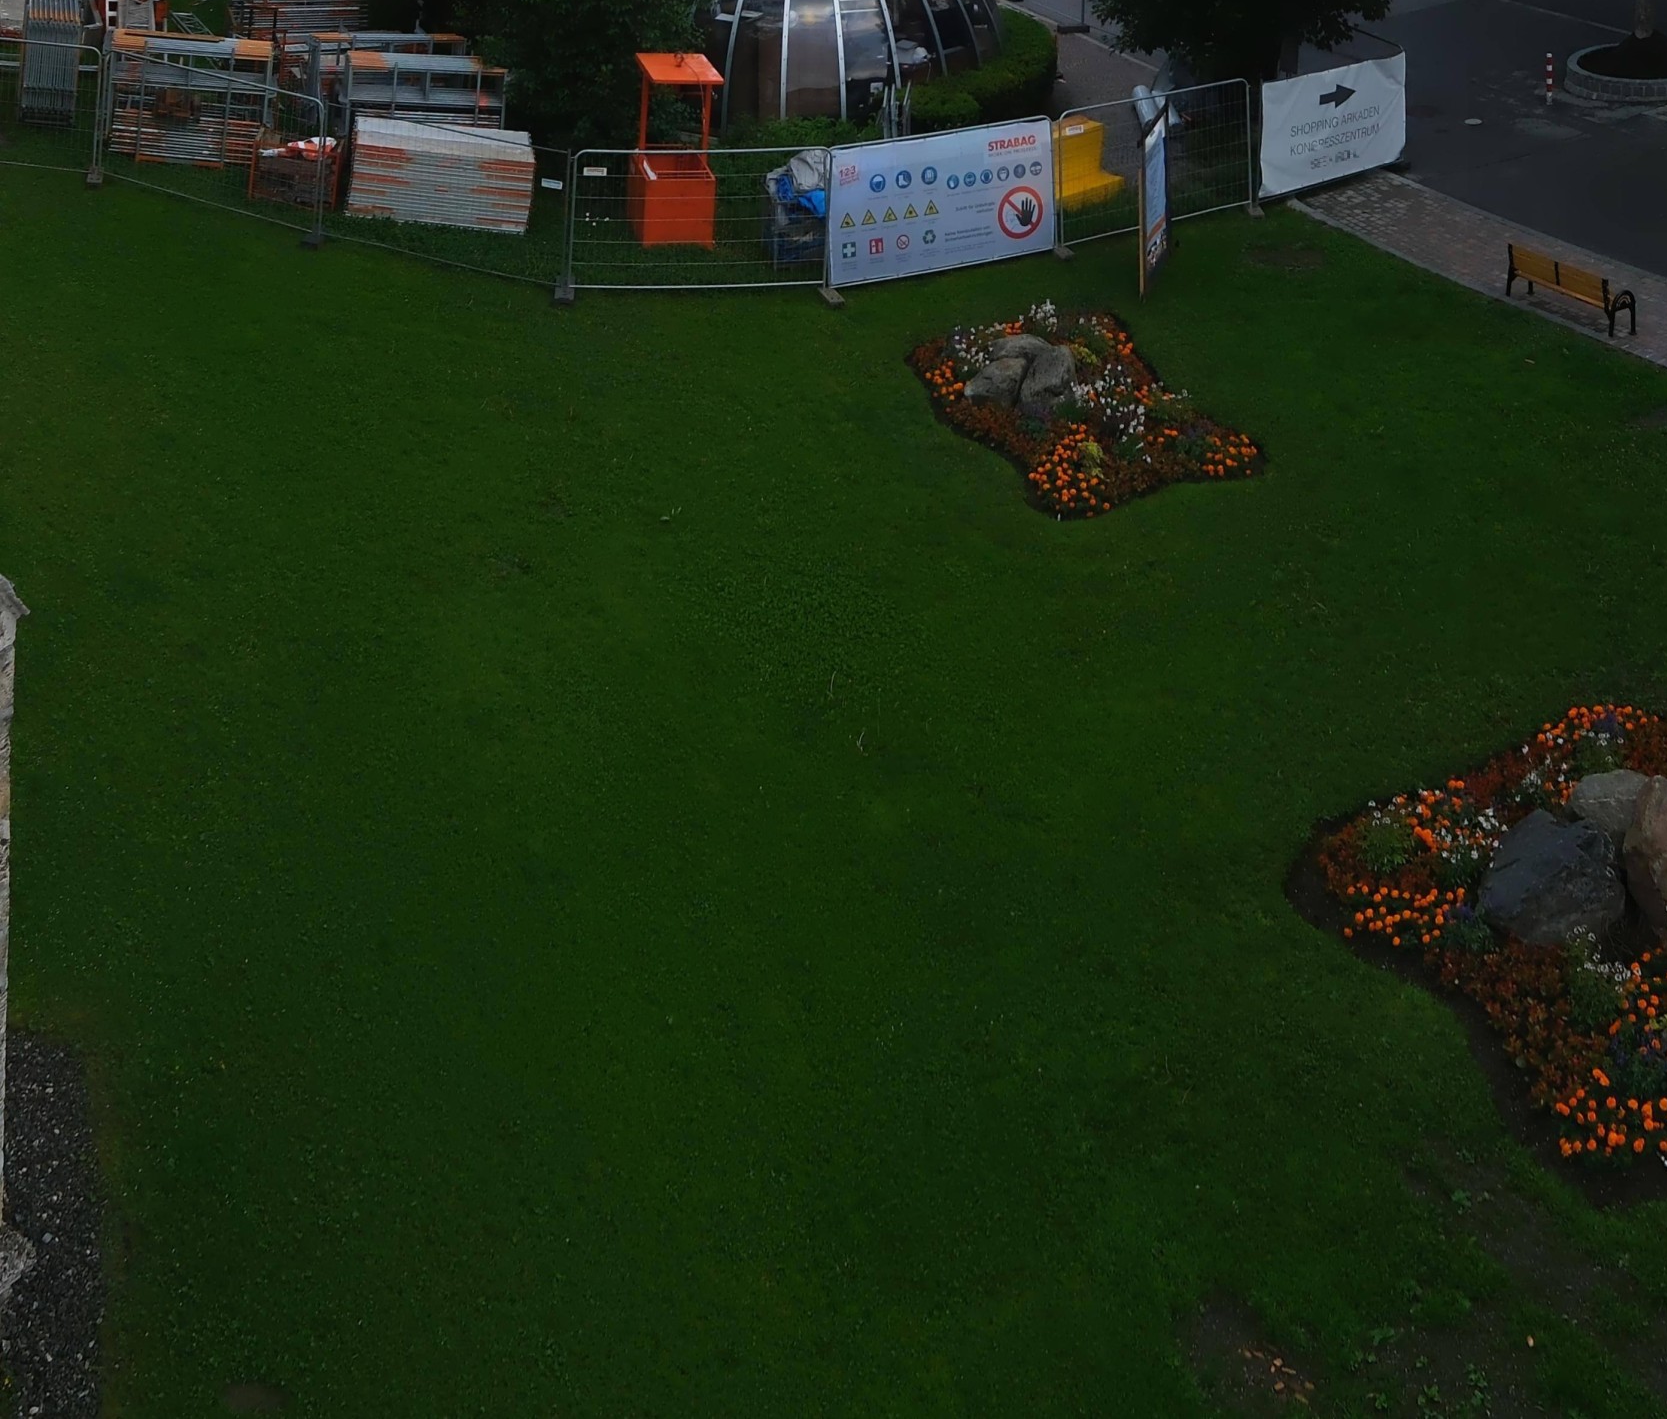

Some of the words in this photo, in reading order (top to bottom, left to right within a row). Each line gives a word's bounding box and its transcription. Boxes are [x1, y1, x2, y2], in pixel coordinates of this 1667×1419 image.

[1290, 118, 1338, 138] SHOPPING
[1340, 106, 1380, 127] ARKADEN
[987, 135, 1036, 151] STRABAG
